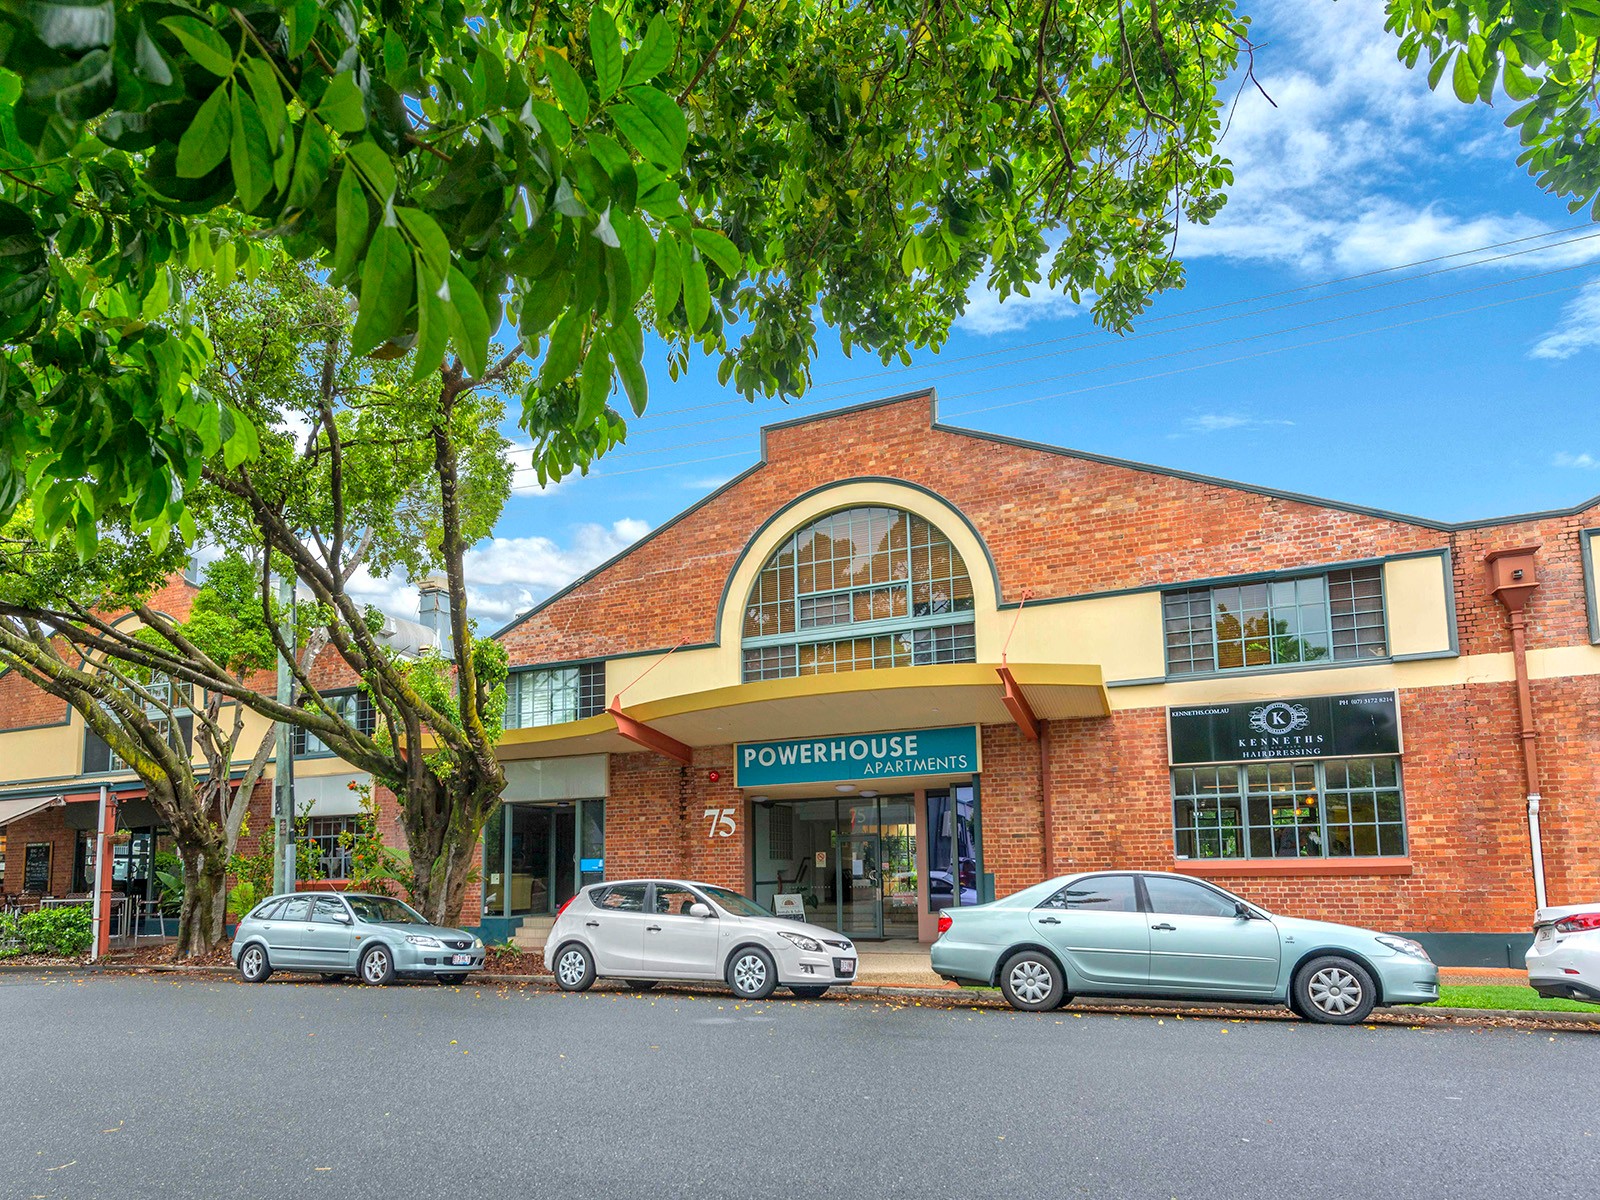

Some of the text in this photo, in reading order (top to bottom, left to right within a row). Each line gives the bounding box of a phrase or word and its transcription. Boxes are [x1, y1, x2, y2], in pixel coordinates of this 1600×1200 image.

[1171, 708, 1230, 717] KENNETHS.COM.AU
[1271, 711, 1286, 725] K
[1238, 735, 1324, 747] KENNETHS
[744, 735, 918, 768] POWERHOUSE
[1242, 748, 1321, 758] HAIRDRESSING
[863, 755, 968, 775] APARTMENTS
[703, 808, 736, 838] 75
